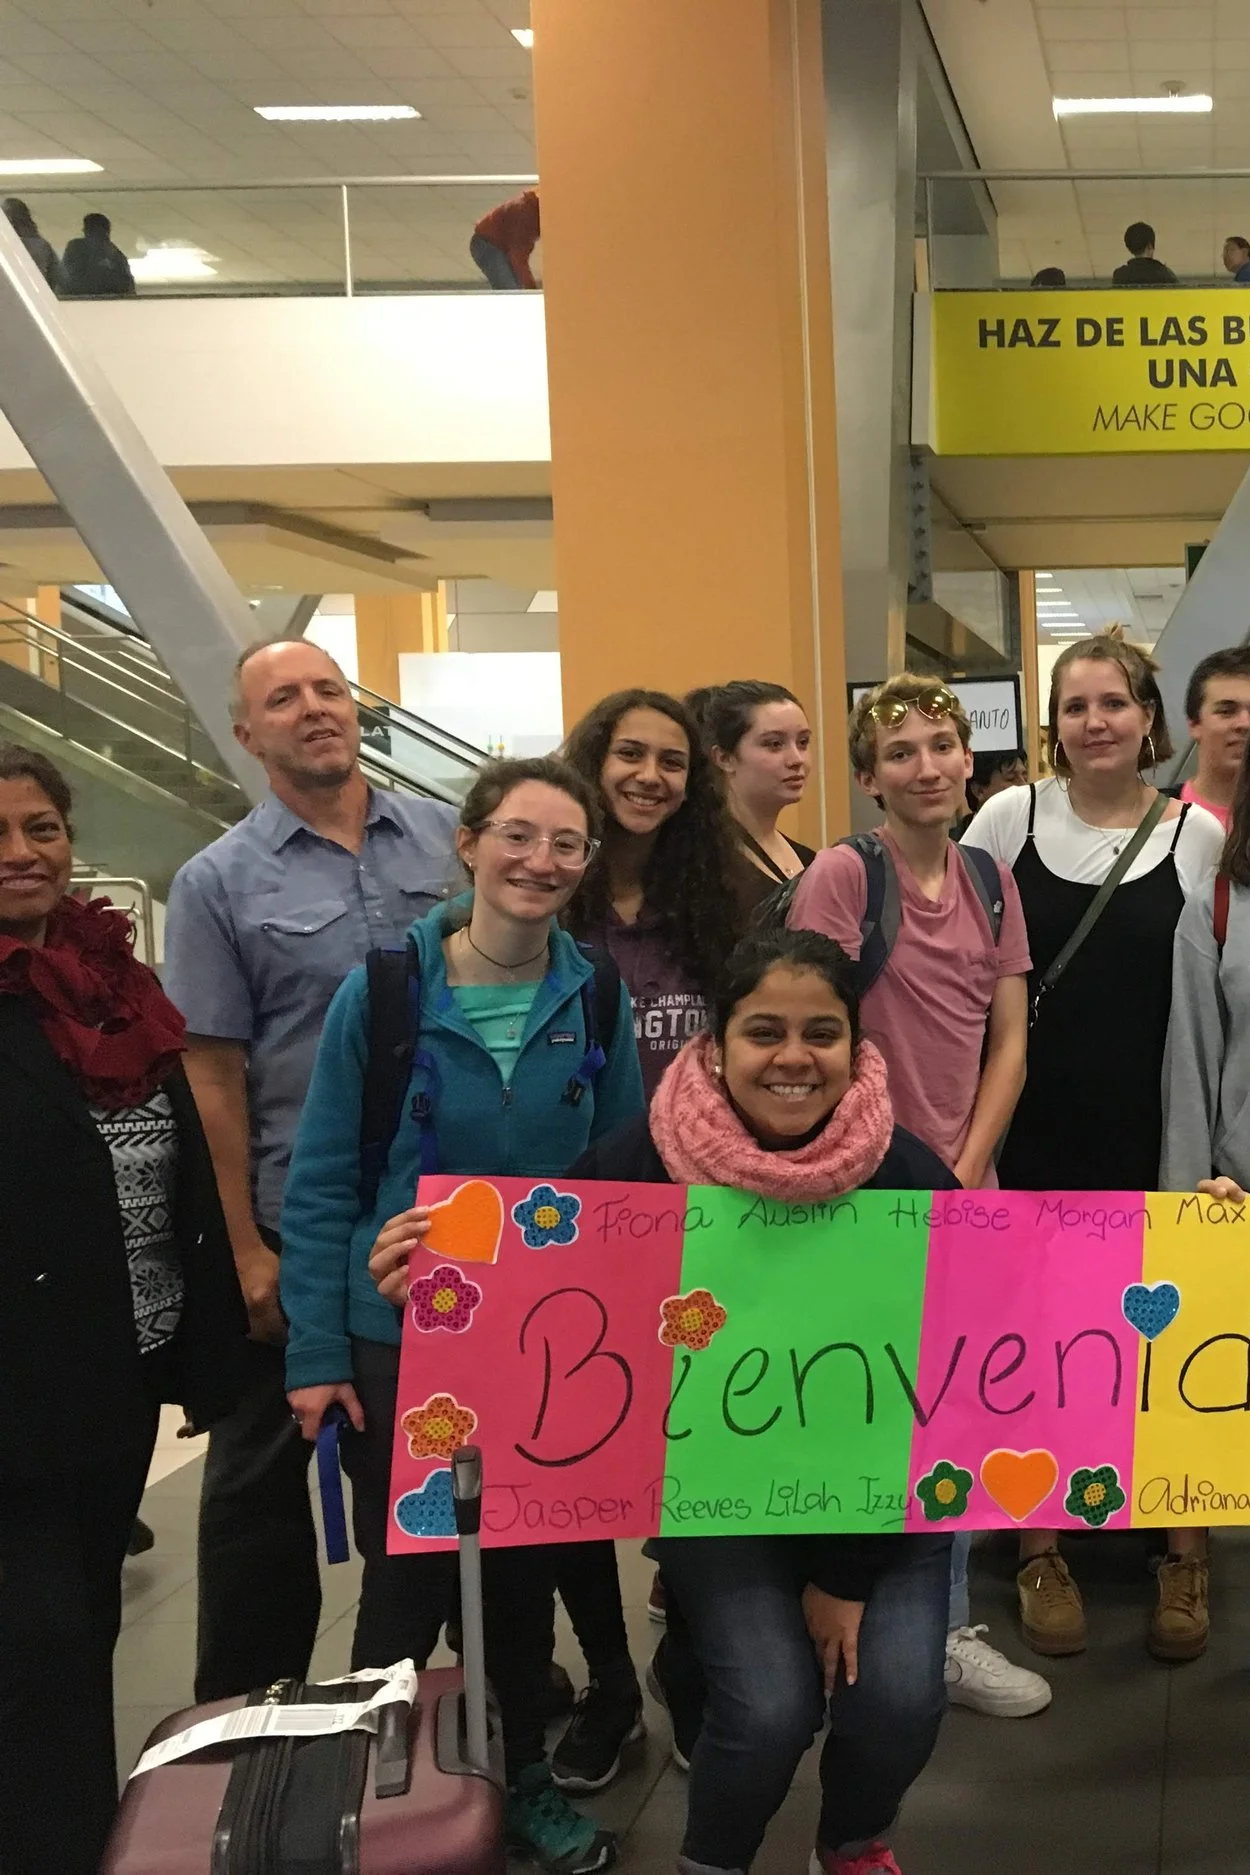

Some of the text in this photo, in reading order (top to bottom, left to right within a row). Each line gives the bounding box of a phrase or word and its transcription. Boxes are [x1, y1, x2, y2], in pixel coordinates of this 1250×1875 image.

[978, 318, 1061, 348] HAZ
[1076, 317, 1124, 347] DE
[1140, 315, 1208, 346] LAS
[1148, 358, 1238, 389] UNA
[1092, 403, 1178, 431] MAKE
[593, 1193, 713, 1243] Fiona
[1036, 1200, 1152, 1240] Morgan
[1176, 1195, 1246, 1225] Max
[482, 1483, 635, 1532] Jasper
[645, 1475, 751, 1523] Reeves
[859, 1476, 912, 1528] Izzy
